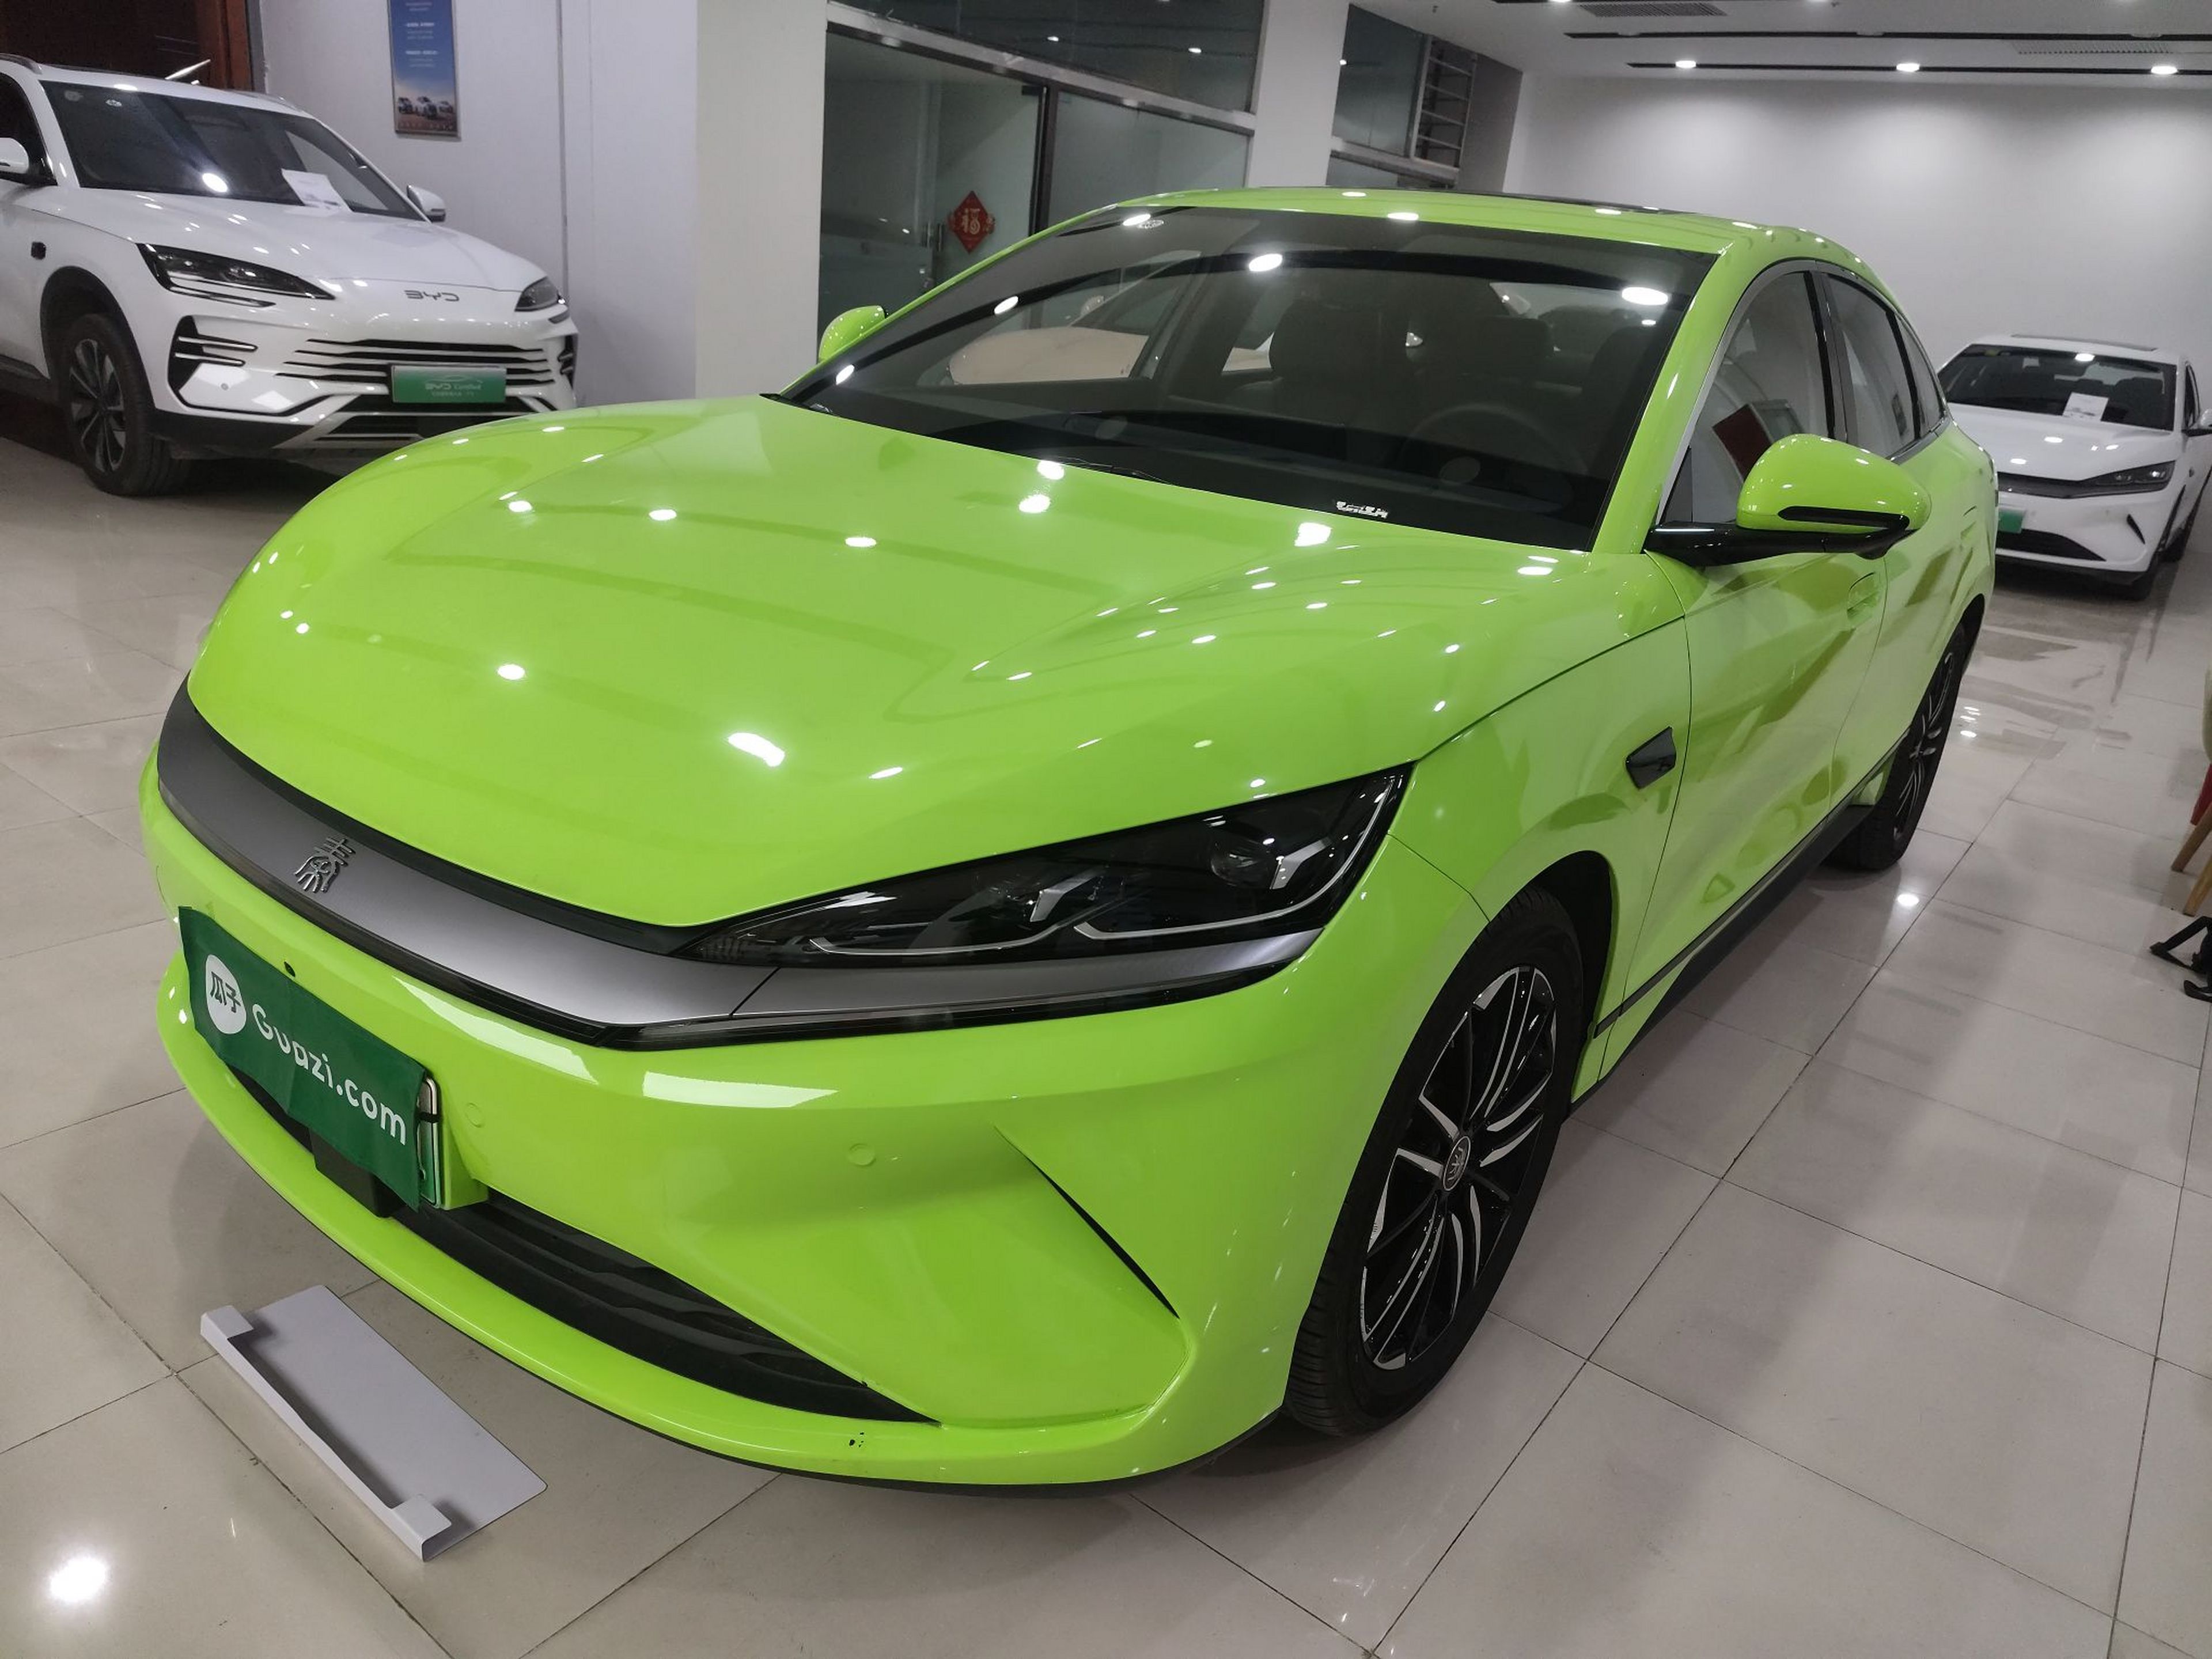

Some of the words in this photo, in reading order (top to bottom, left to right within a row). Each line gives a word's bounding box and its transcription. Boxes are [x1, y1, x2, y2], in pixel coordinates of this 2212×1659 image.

[962, 208, 980, 234] 福
[404, 290, 459, 301] BYD
[210, 971, 241, 1014] 瓜子
[252, 1003, 407, 1146] Guazi.com
